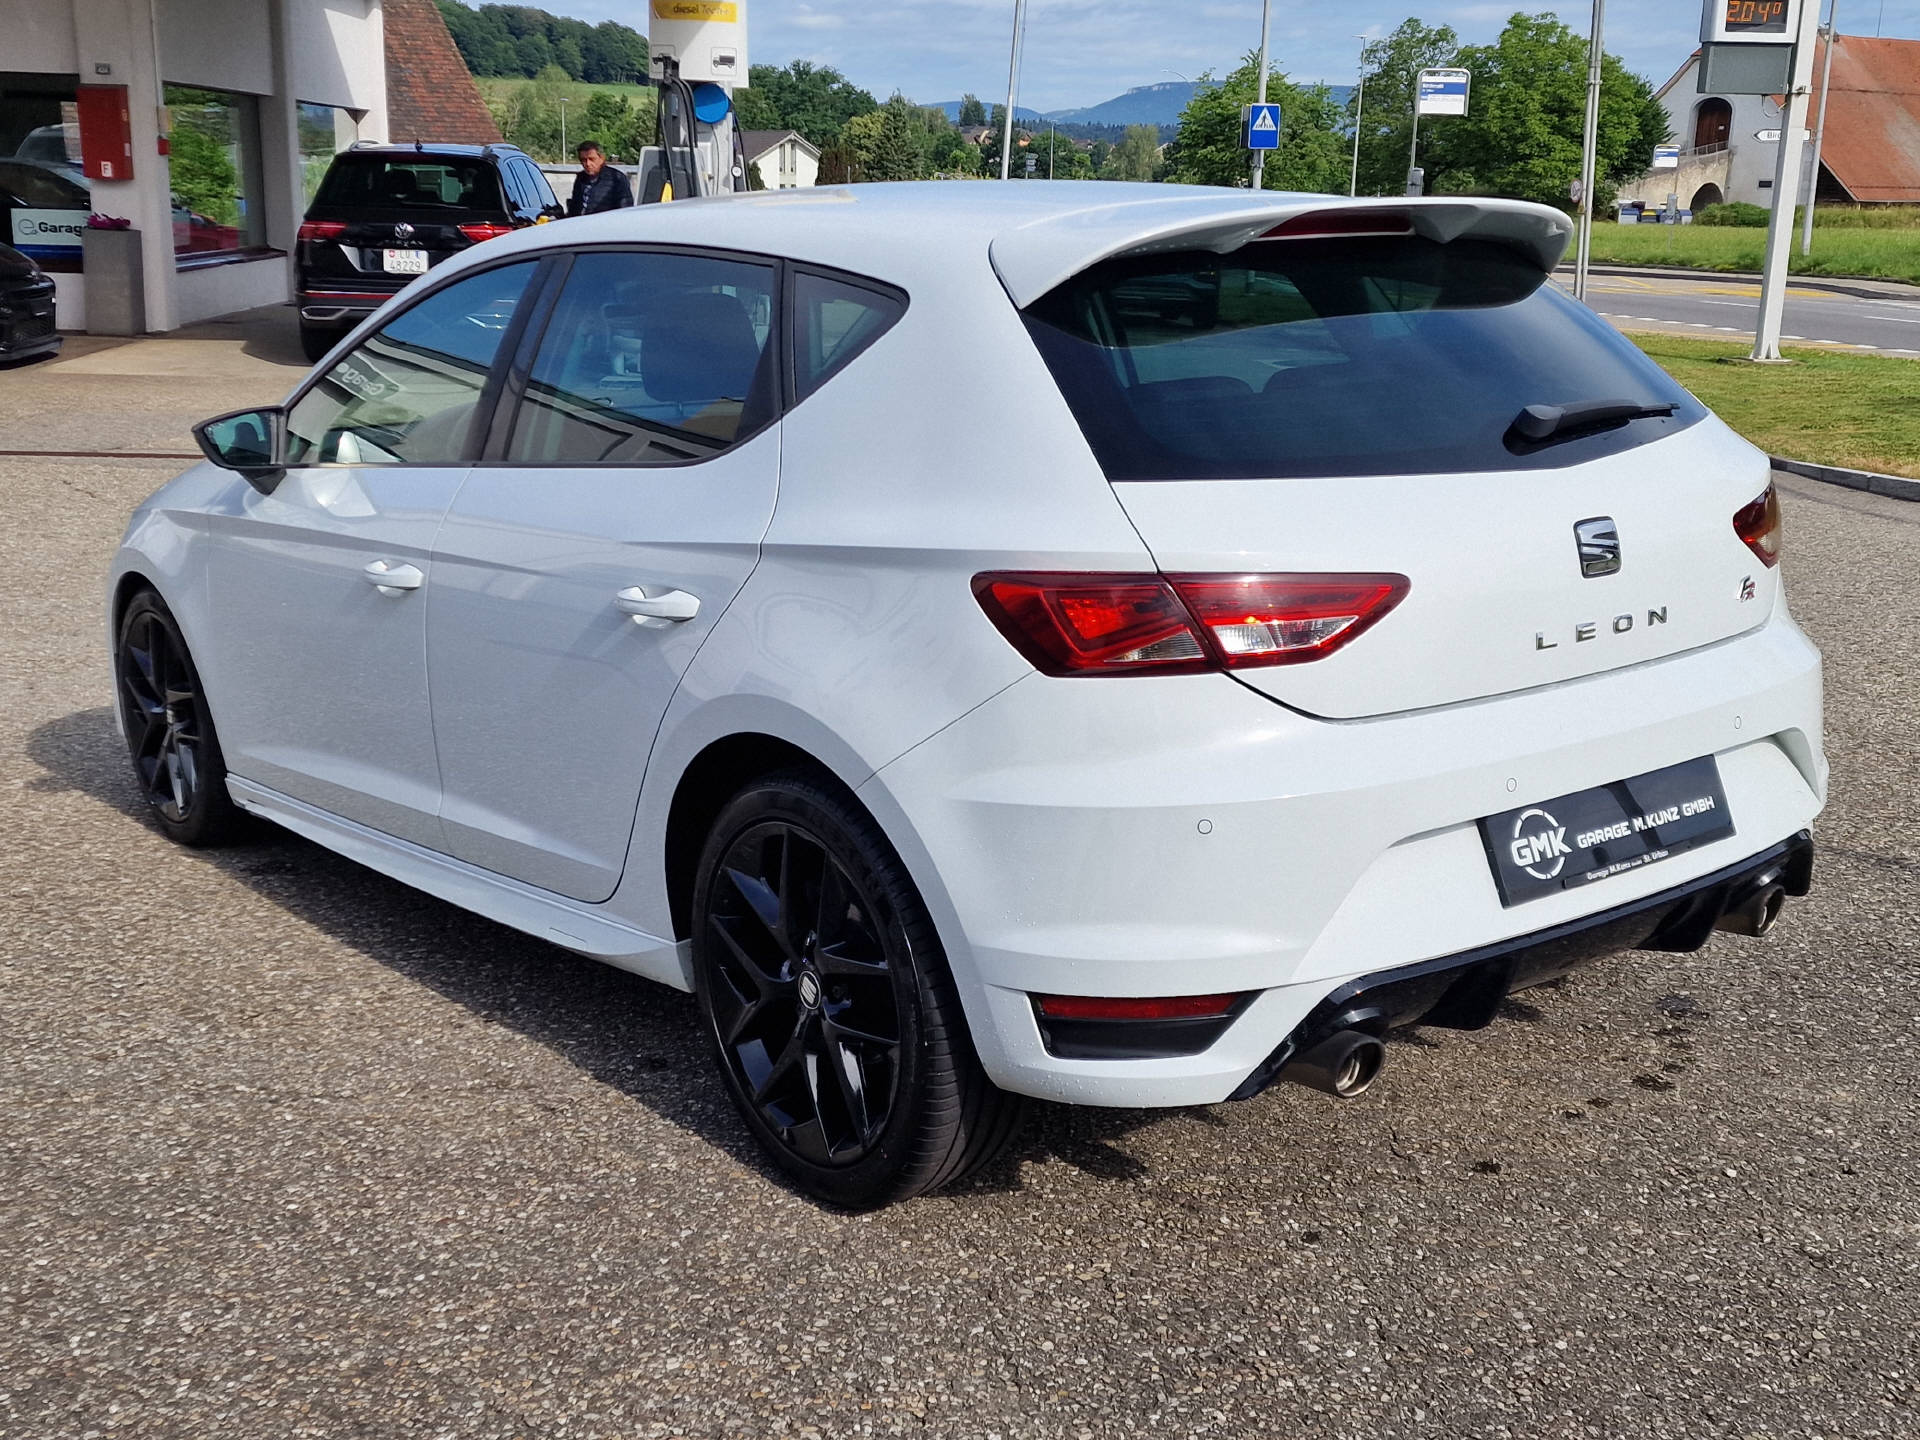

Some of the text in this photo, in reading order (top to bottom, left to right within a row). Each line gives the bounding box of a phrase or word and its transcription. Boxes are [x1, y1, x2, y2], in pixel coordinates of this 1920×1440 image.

[39, 221, 88, 237] Garag
[1535, 605, 1668, 651] LEON
[1576, 796, 1716, 849] GARAGE M.KUNZ GMBH
[1511, 826, 1573, 867] GMK
